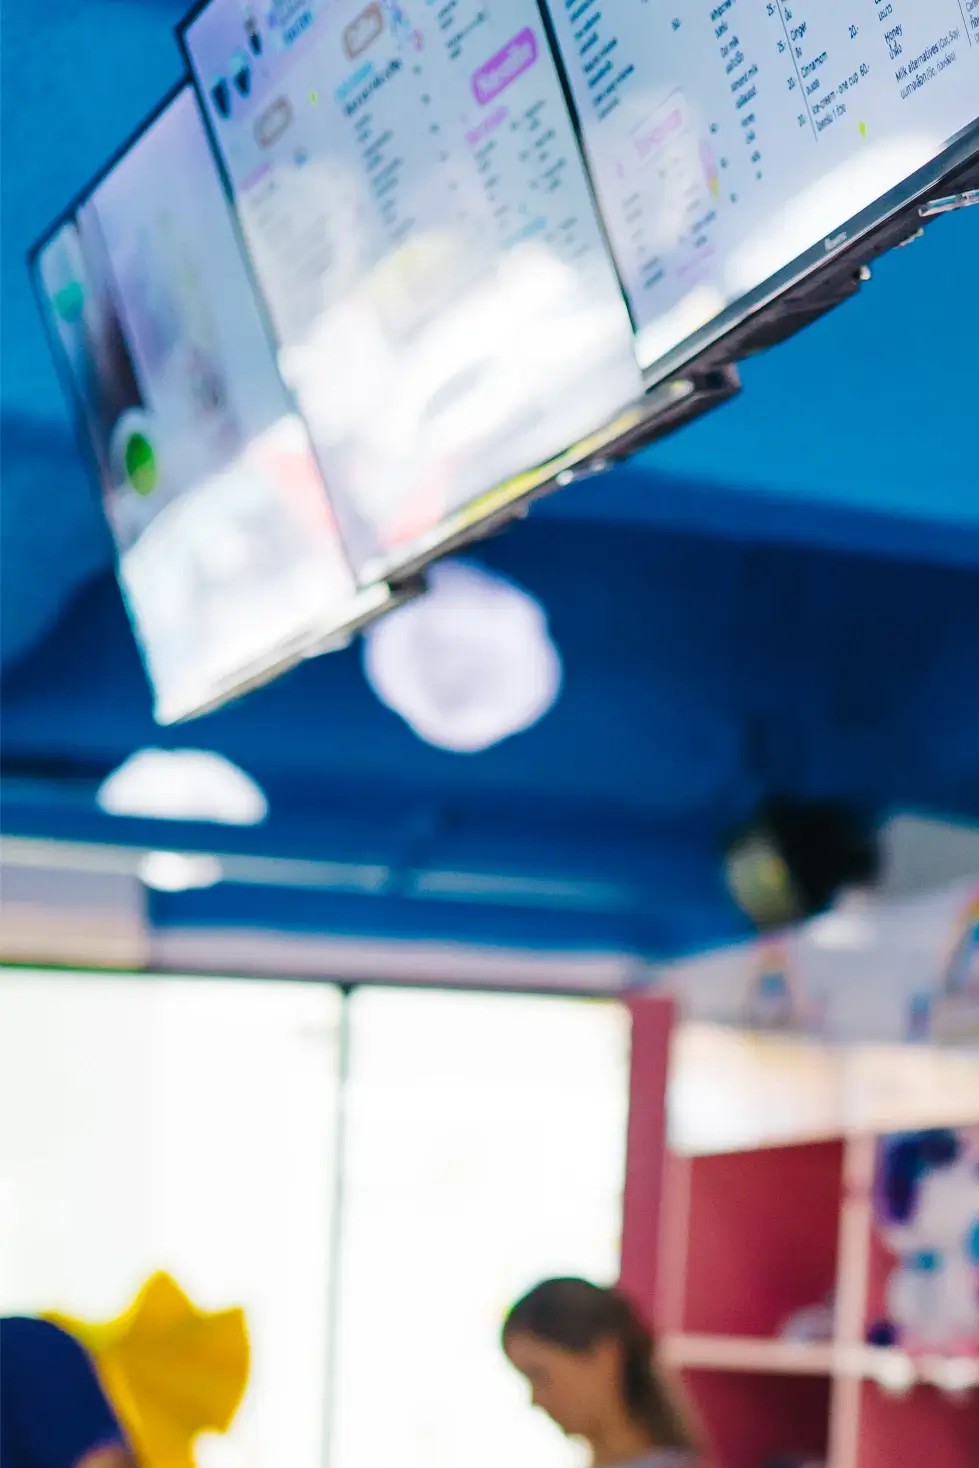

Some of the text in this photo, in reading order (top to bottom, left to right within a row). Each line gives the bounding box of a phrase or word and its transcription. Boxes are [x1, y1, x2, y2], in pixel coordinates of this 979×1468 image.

[884, 24, 903, 44] Honey
[895, 66, 908, 84] Milk
[907, 43, 940, 78] alternatives
